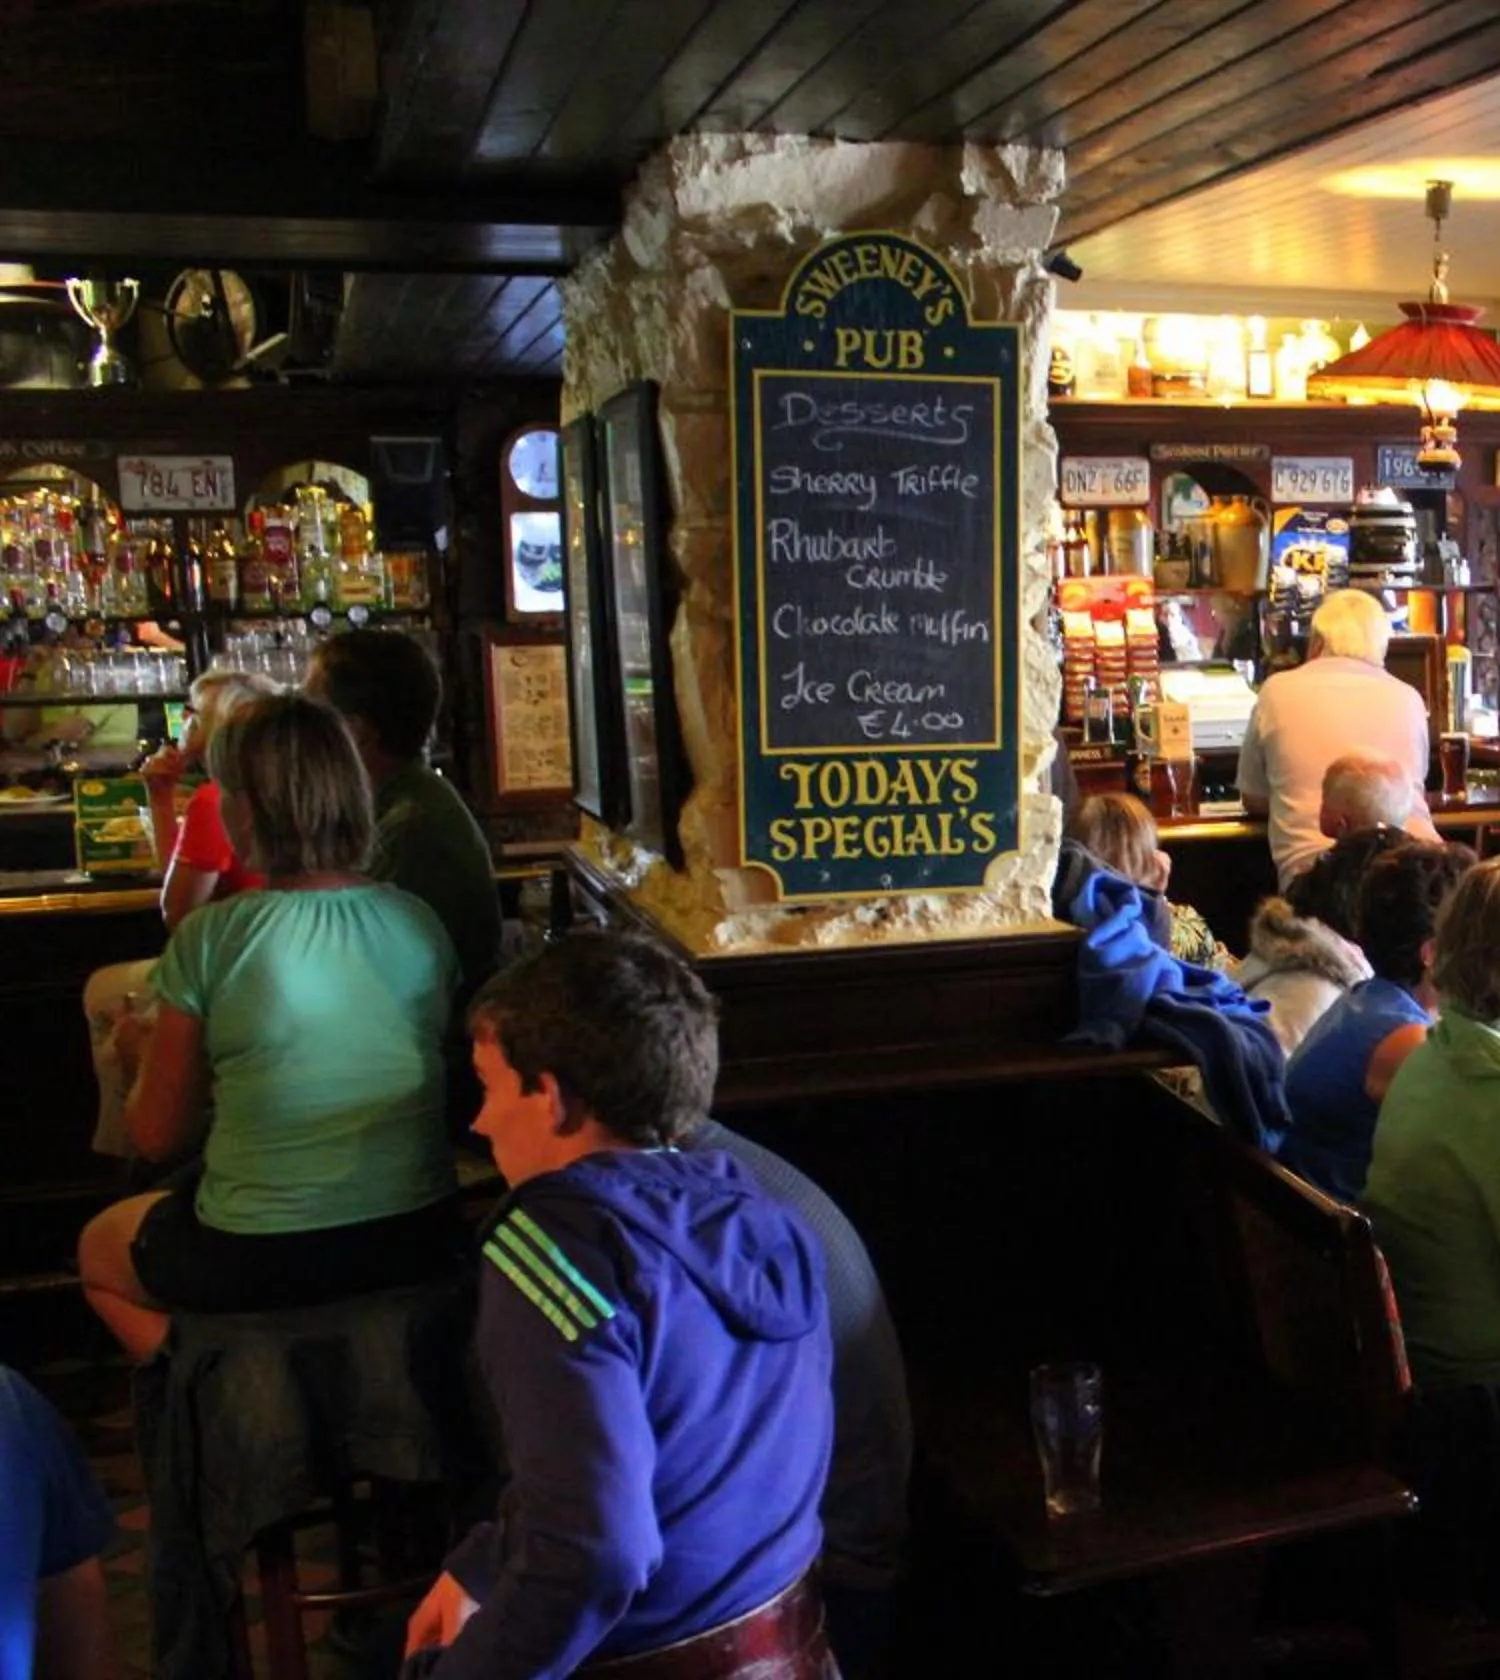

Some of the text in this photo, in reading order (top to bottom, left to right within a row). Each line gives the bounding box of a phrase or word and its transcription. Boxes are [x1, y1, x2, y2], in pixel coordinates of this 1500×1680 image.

[796, 244, 954, 326] SWEENEY'S
[834, 327, 926, 369] PUB
[771, 393, 974, 450] Desserts
[845, 556, 949, 592] Crumble
[773, 602, 900, 639] Chocolate
[780, 661, 946, 710] Ice Cream
[768, 806, 998, 863] SPECIAL'S
